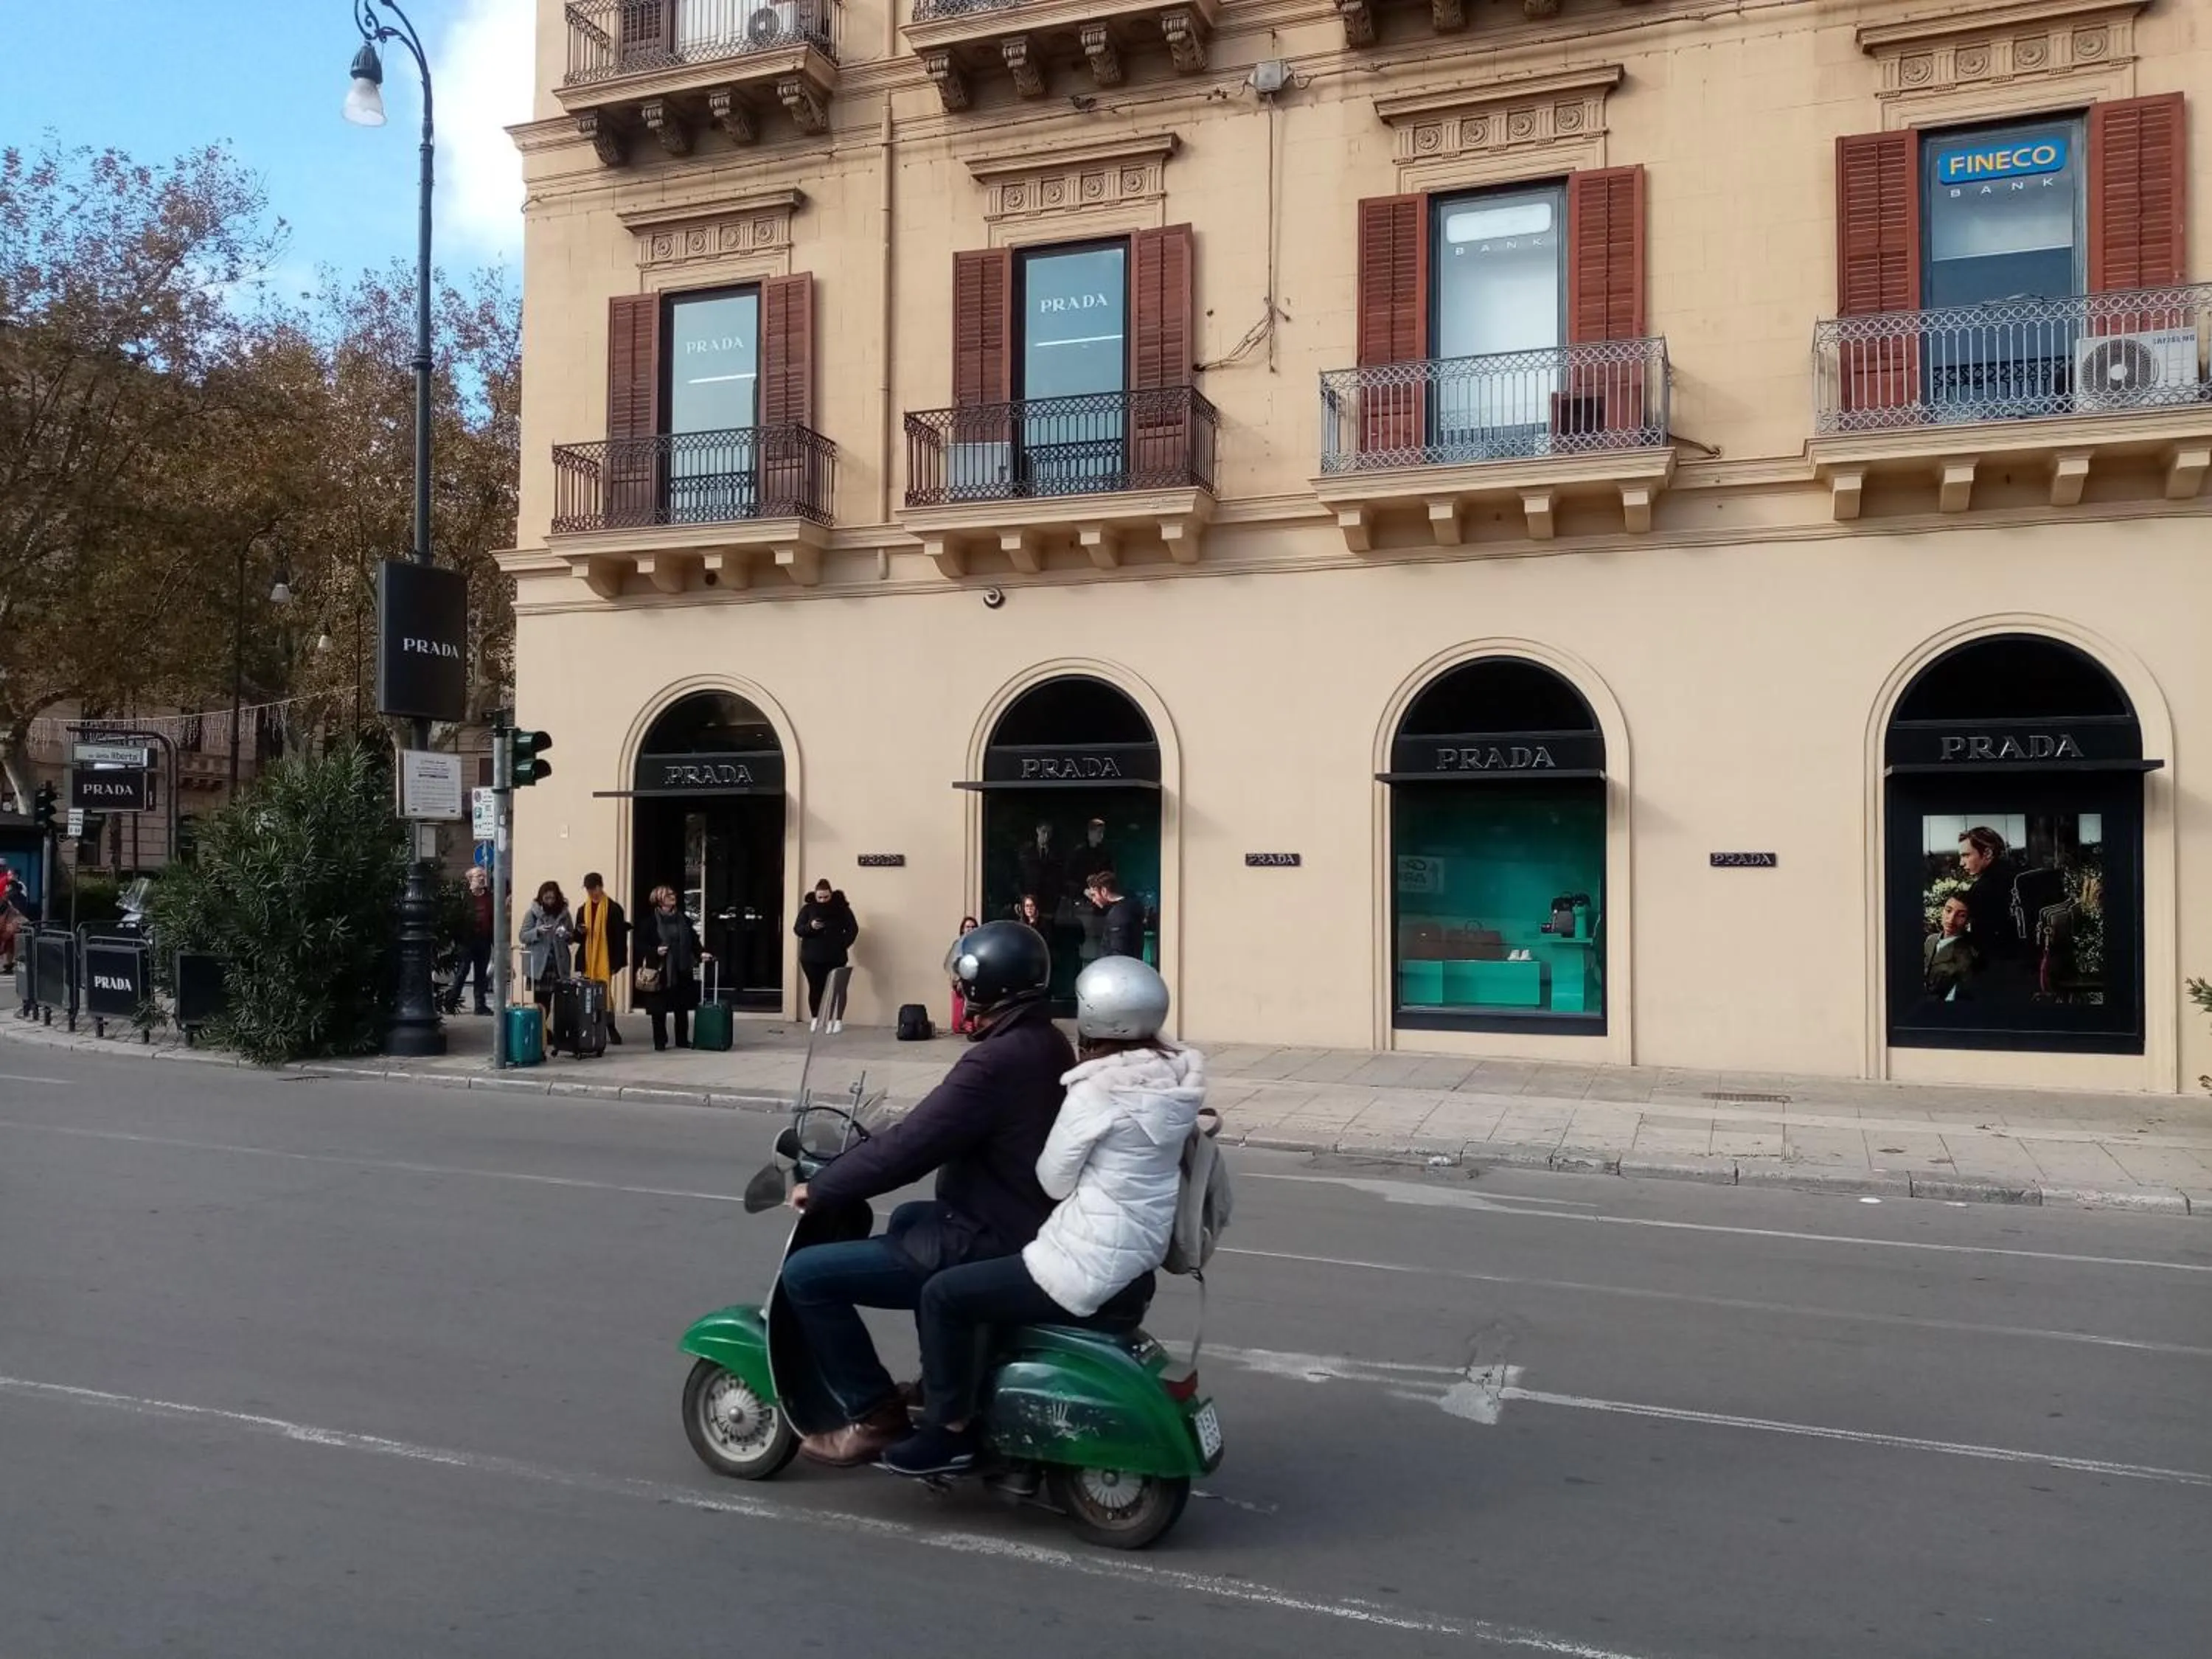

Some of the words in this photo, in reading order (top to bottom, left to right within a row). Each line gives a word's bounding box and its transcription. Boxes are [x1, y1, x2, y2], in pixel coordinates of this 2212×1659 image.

[1950, 145, 2056, 175] FINECO
[1950, 178, 2053, 198] BANK
[1455, 237, 1544, 256] BANK
[1040, 293, 1108, 313] PRADA
[686, 336, 744, 354] PRADA
[403, 637, 459, 659] PRADA
[1940, 734, 2085, 760] PRADA
[1436, 746, 1557, 769] PRADA
[664, 765, 753, 784] PRADA
[1021, 757, 1121, 779] PRADA
[83, 784, 133, 795] PRADA
[1248, 854, 1295, 865] PRADA
[1712, 853, 1771, 865] PRADA
[94, 975, 132, 992] PRADA
